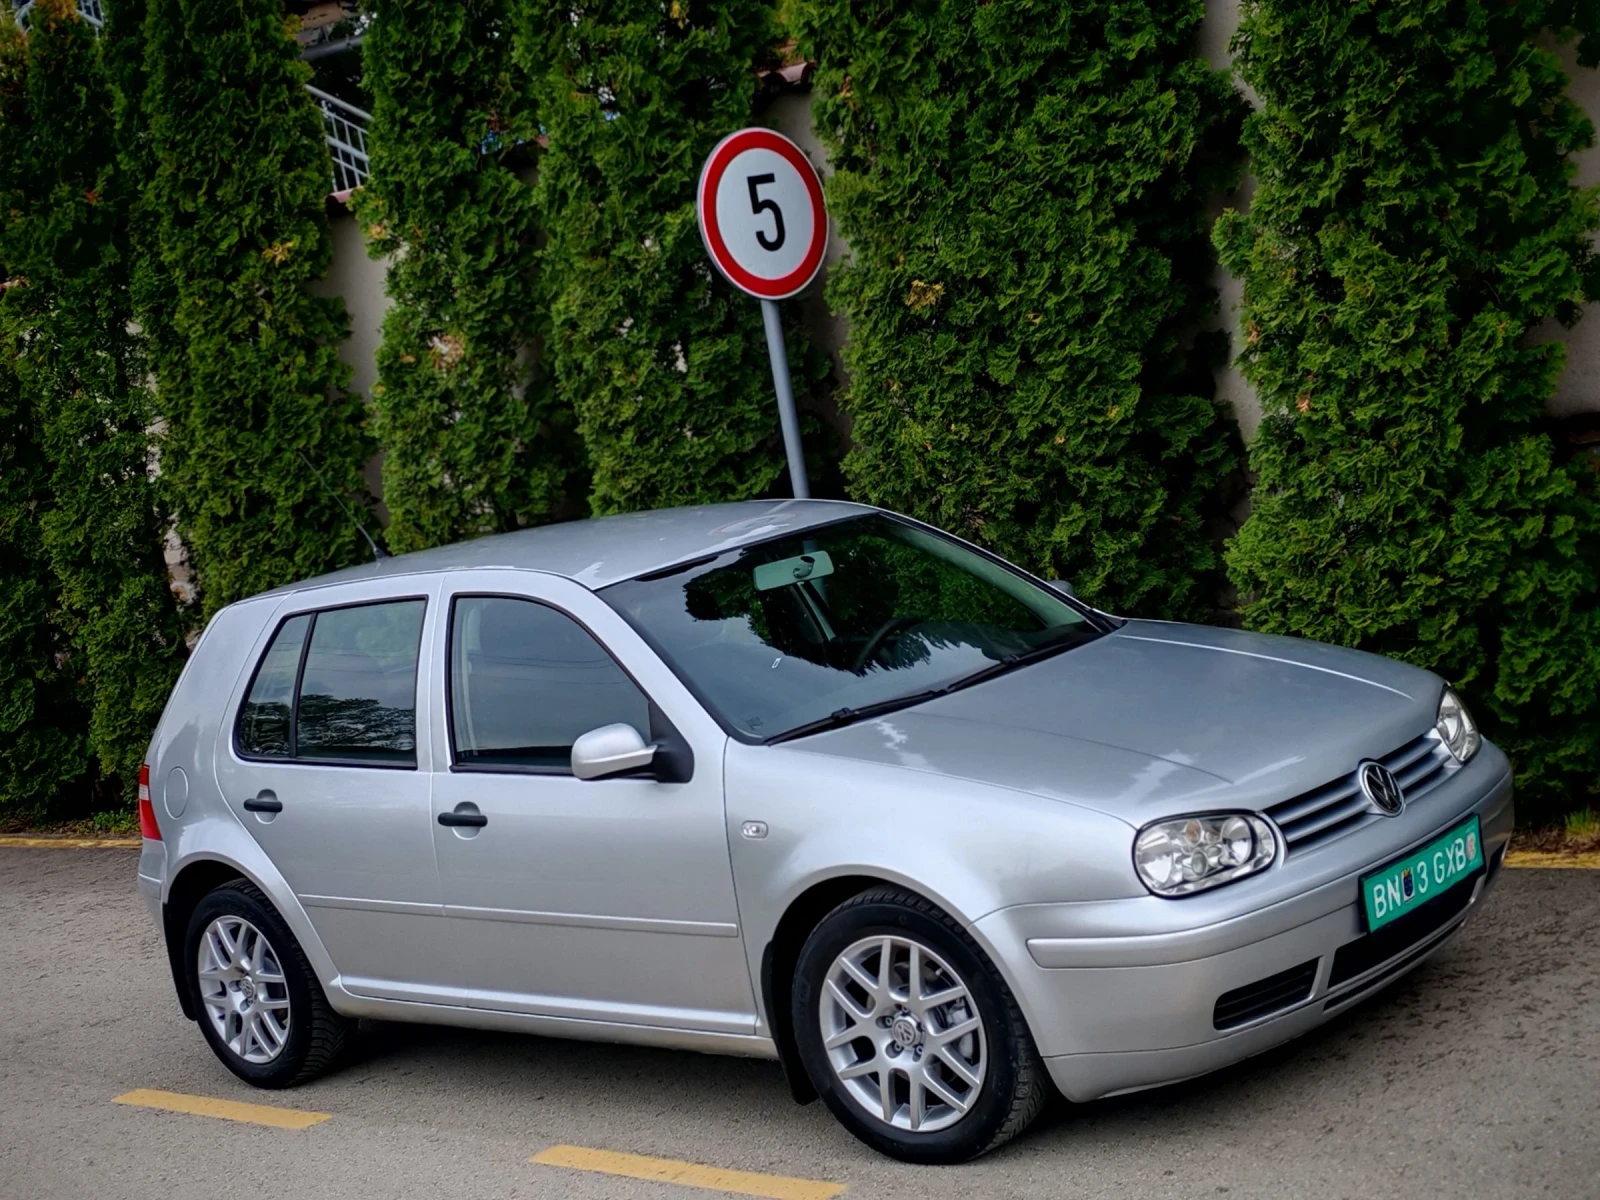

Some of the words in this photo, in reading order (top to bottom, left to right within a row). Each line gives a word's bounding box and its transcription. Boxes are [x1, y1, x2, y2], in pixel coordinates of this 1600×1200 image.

[747, 172, 786, 252] 5
[1363, 764, 1402, 812] VW
[1373, 874, 1401, 919] BN
[1417, 861, 1429, 894] 3
